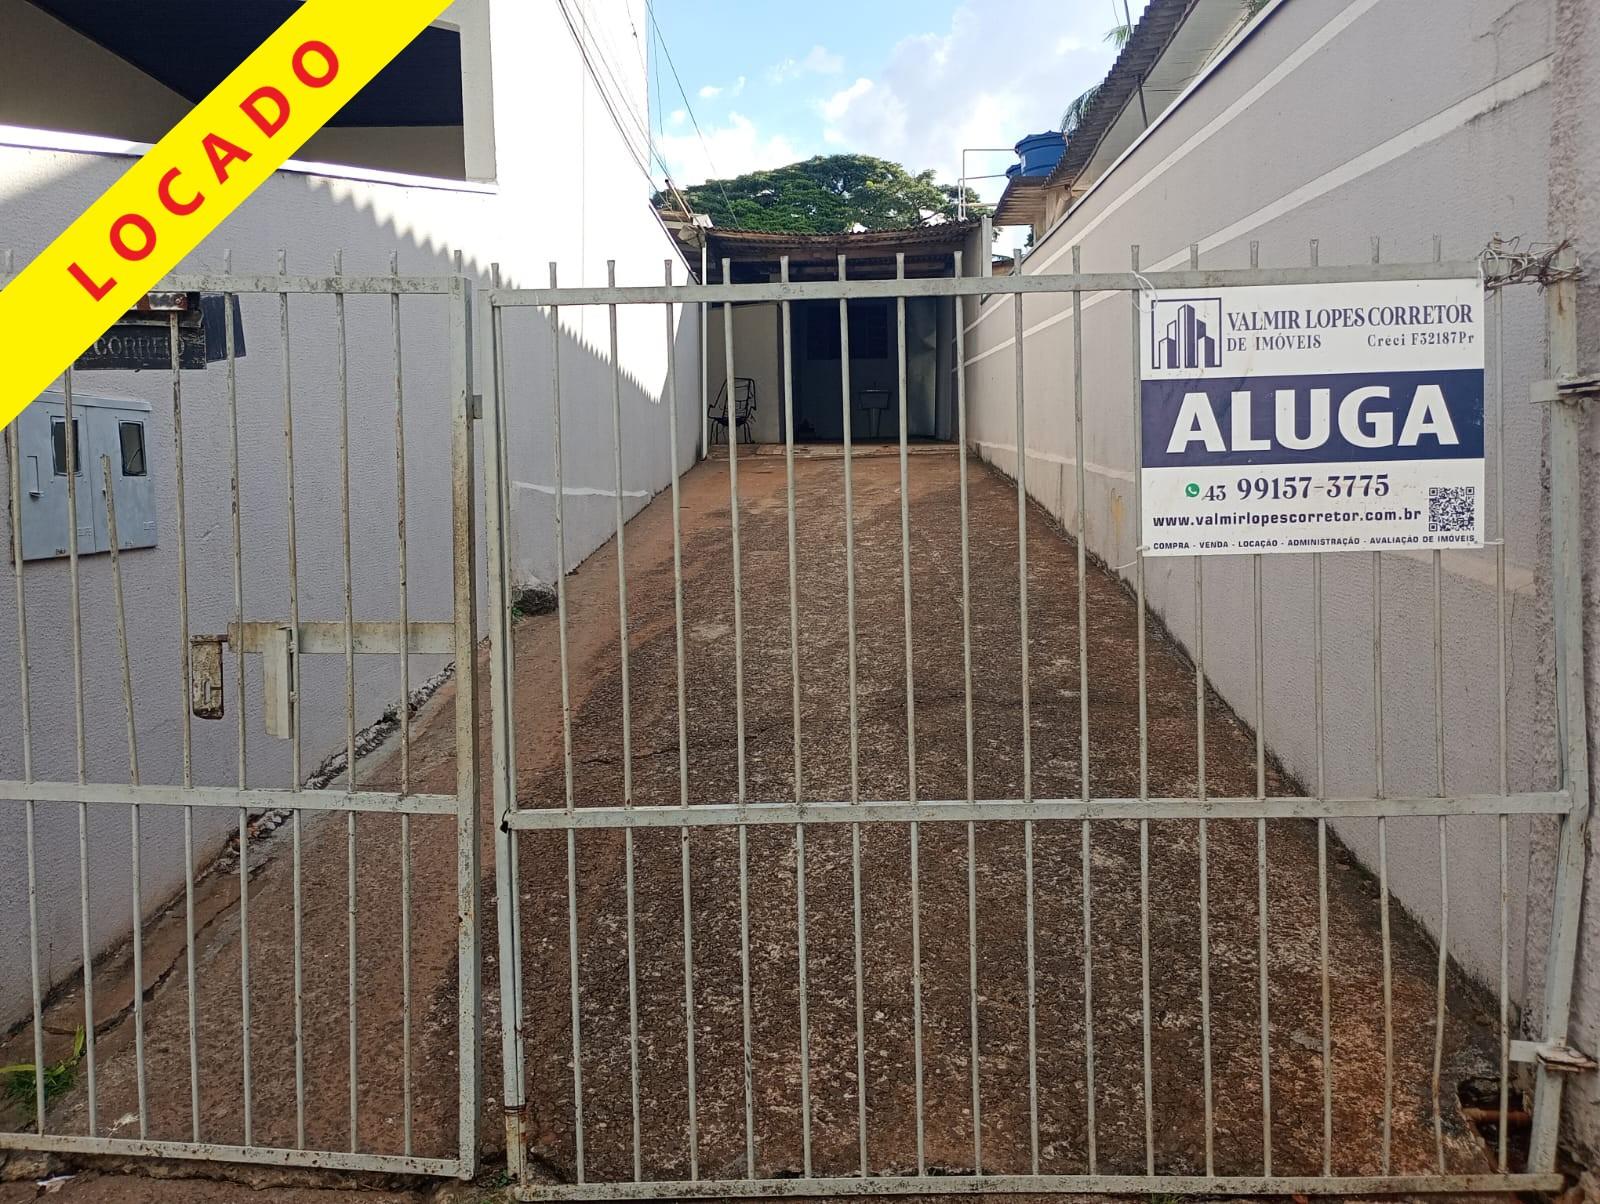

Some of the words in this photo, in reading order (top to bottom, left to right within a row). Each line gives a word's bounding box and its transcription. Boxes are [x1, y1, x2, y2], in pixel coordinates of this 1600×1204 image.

[1227, 310, 1300, 331] VALMIR
[1305, 307, 1365, 329] LOPES
[1368, 304, 1473, 326] CORRETOR
[1227, 337, 1247, 352] DE
[1255, 332, 1322, 351] IMÓVEIS
[1166, 384, 1460, 454] ALUGA
[1203, 484, 1227, 501] 43
[1237, 473, 1390, 500] 99157-3775
[1153, 508, 1422, 527] www.valmirlopescorretor.com.br
[1238, 538, 1278, 549] LOCAÇÃO
[1287, 536, 1360, 547] ADMINISTRAÇÃO
[1370, 535, 1419, 545] AVALIAÇÃO
[1422, 535, 1434, 543] DE
[1437, 533, 1475, 543] IMÓVEIS
